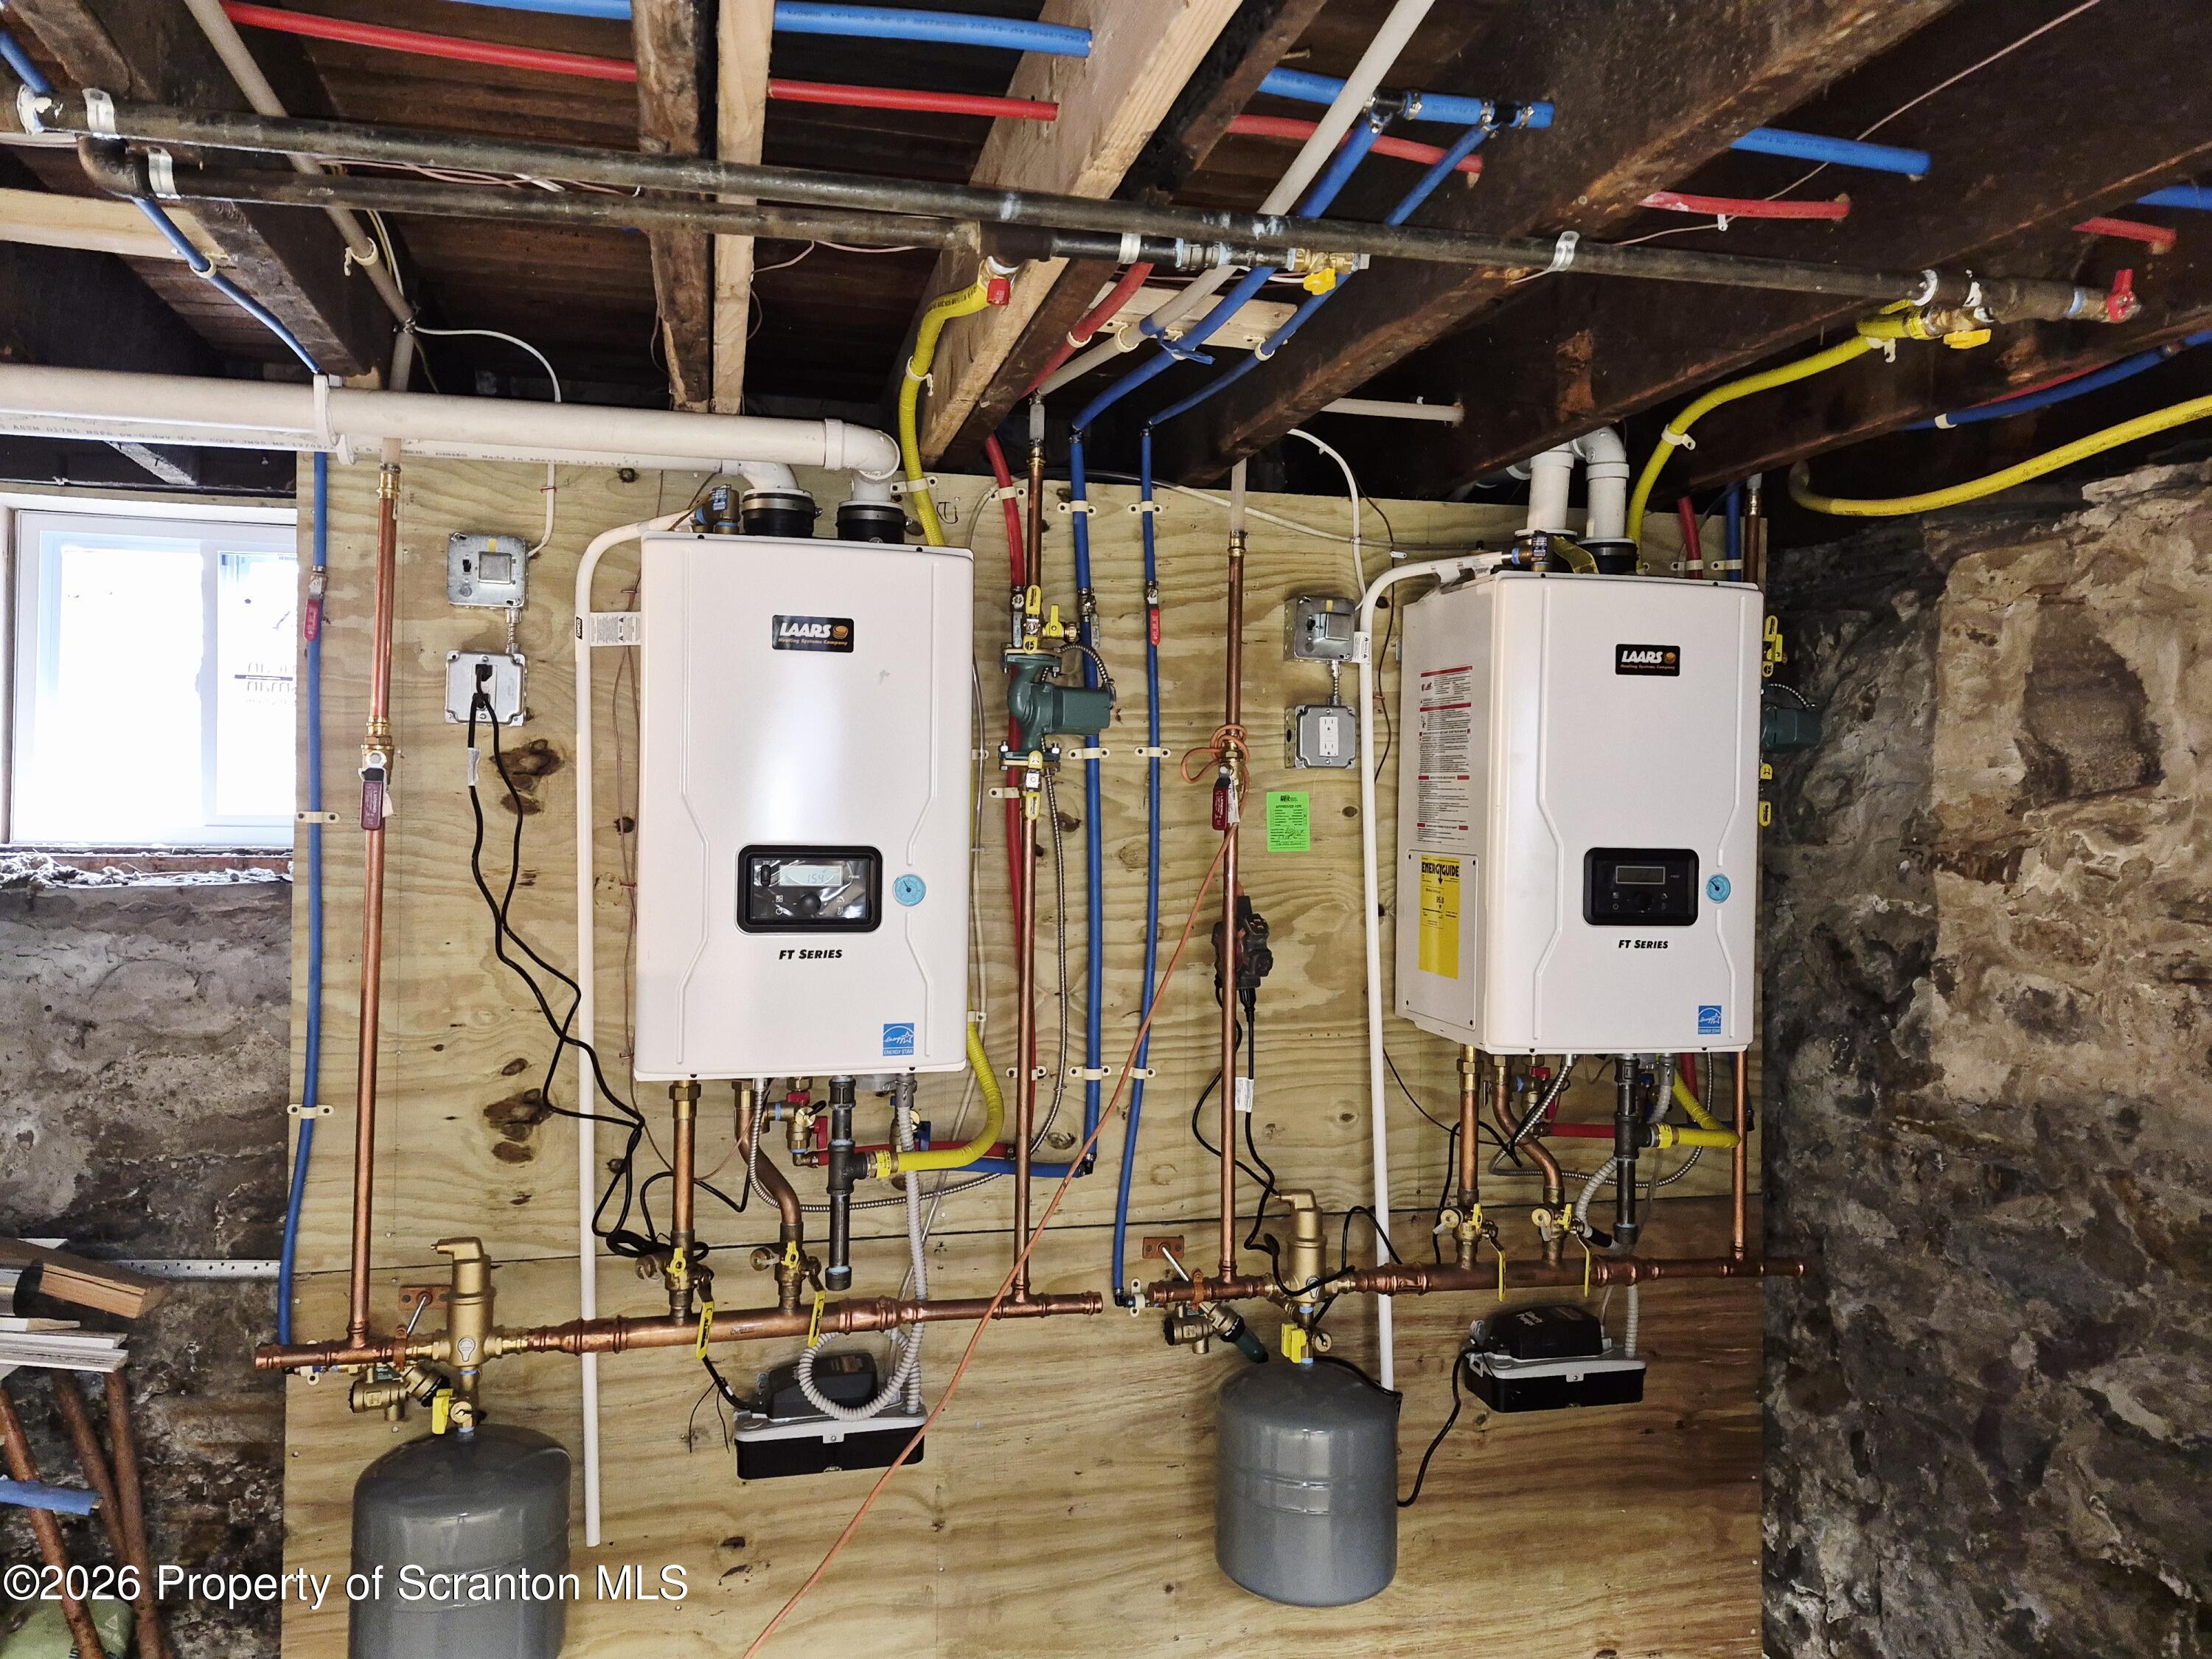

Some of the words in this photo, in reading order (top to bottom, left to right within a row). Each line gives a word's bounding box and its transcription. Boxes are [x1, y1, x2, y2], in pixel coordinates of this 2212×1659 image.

[779, 622, 832, 638] LAARS
[1621, 650, 1663, 664] LAARS
[1618, 939, 1631, 949] FT
[779, 949, 795, 959] FT
